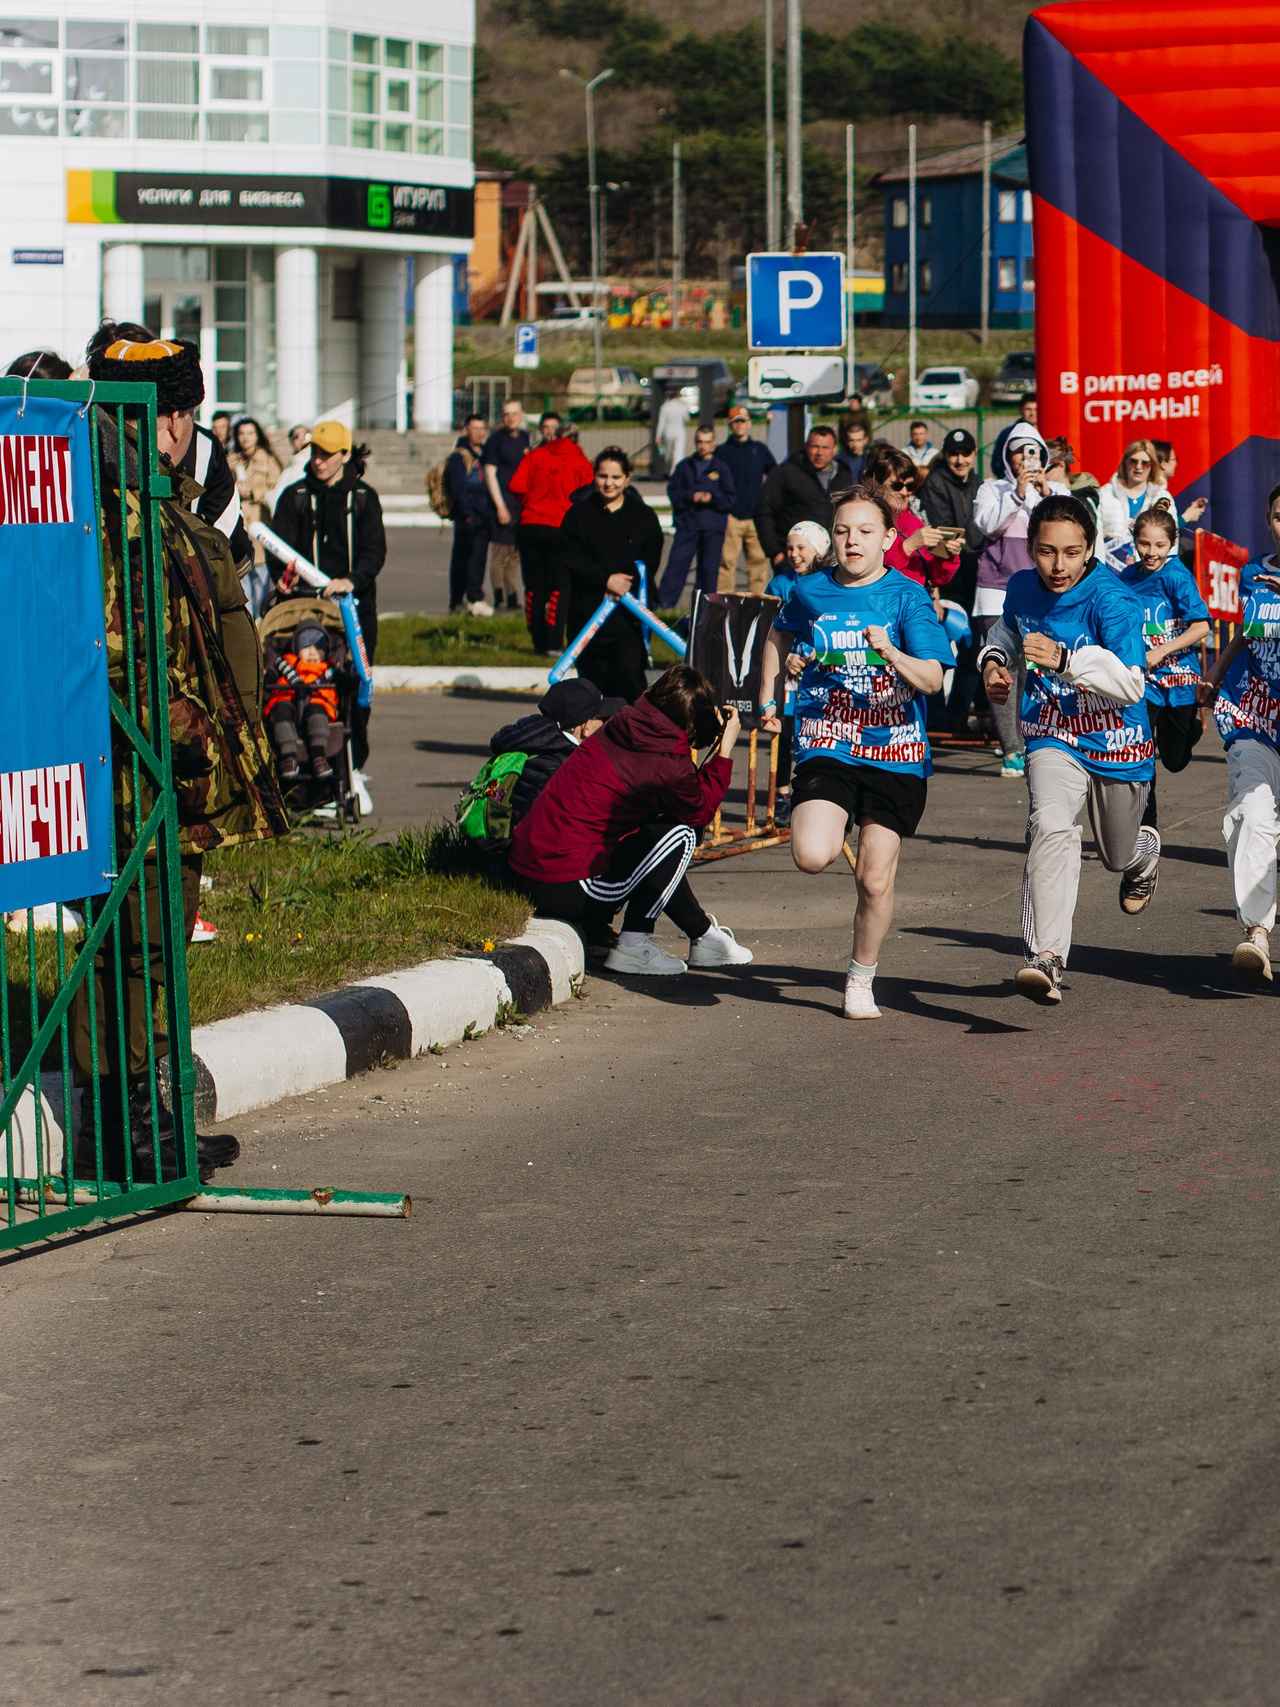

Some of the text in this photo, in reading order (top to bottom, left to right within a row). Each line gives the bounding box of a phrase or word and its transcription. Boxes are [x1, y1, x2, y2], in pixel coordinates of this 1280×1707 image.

[137, 188, 305, 207] УСЛУГИ ДЛЯ БИЗНЕСА
[779, 270, 823, 335] P
[519, 328, 534, 351] P
[1060, 364, 1222, 396] В ритме всей
[1084, 395, 1200, 423] СТРАНЫ!
[822, 704, 907, 728] #ГОРДОСТЬ
[889, 721, 922, 746] 2024
[1105, 724, 1144, 751] 2024
